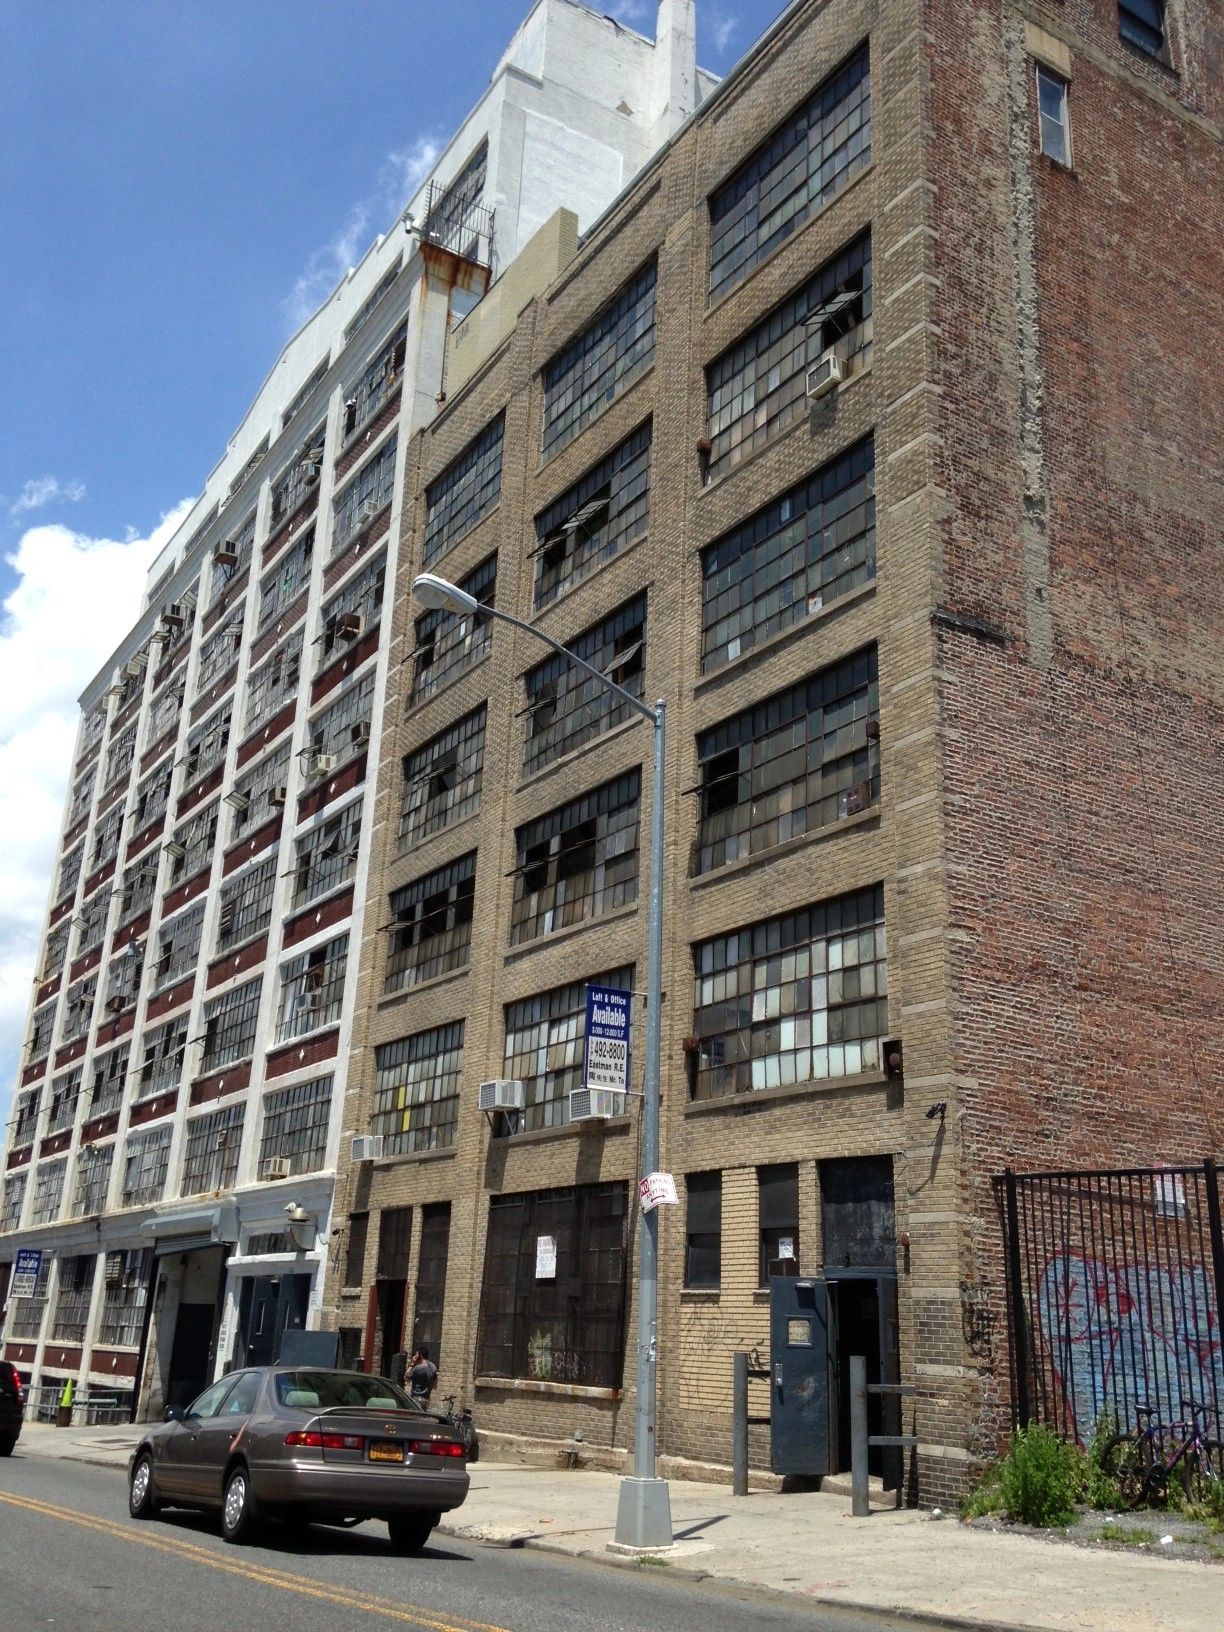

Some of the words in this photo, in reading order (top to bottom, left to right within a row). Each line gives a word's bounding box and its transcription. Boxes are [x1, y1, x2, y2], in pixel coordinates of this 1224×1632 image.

[592, 992, 603, 1002] Loft
[605, 994, 609, 1003] &
[611, 995, 626, 1005] Office
[592, 1004, 626, 1028] Available
[594, 1040, 625, 1061] 492-8800
[589, 1060, 612, 1072] Eastman
[618, 1076, 625, 1085] To
[640, 1180, 650, 1196] NO
[649, 1178, 671, 1187] PARKNG
